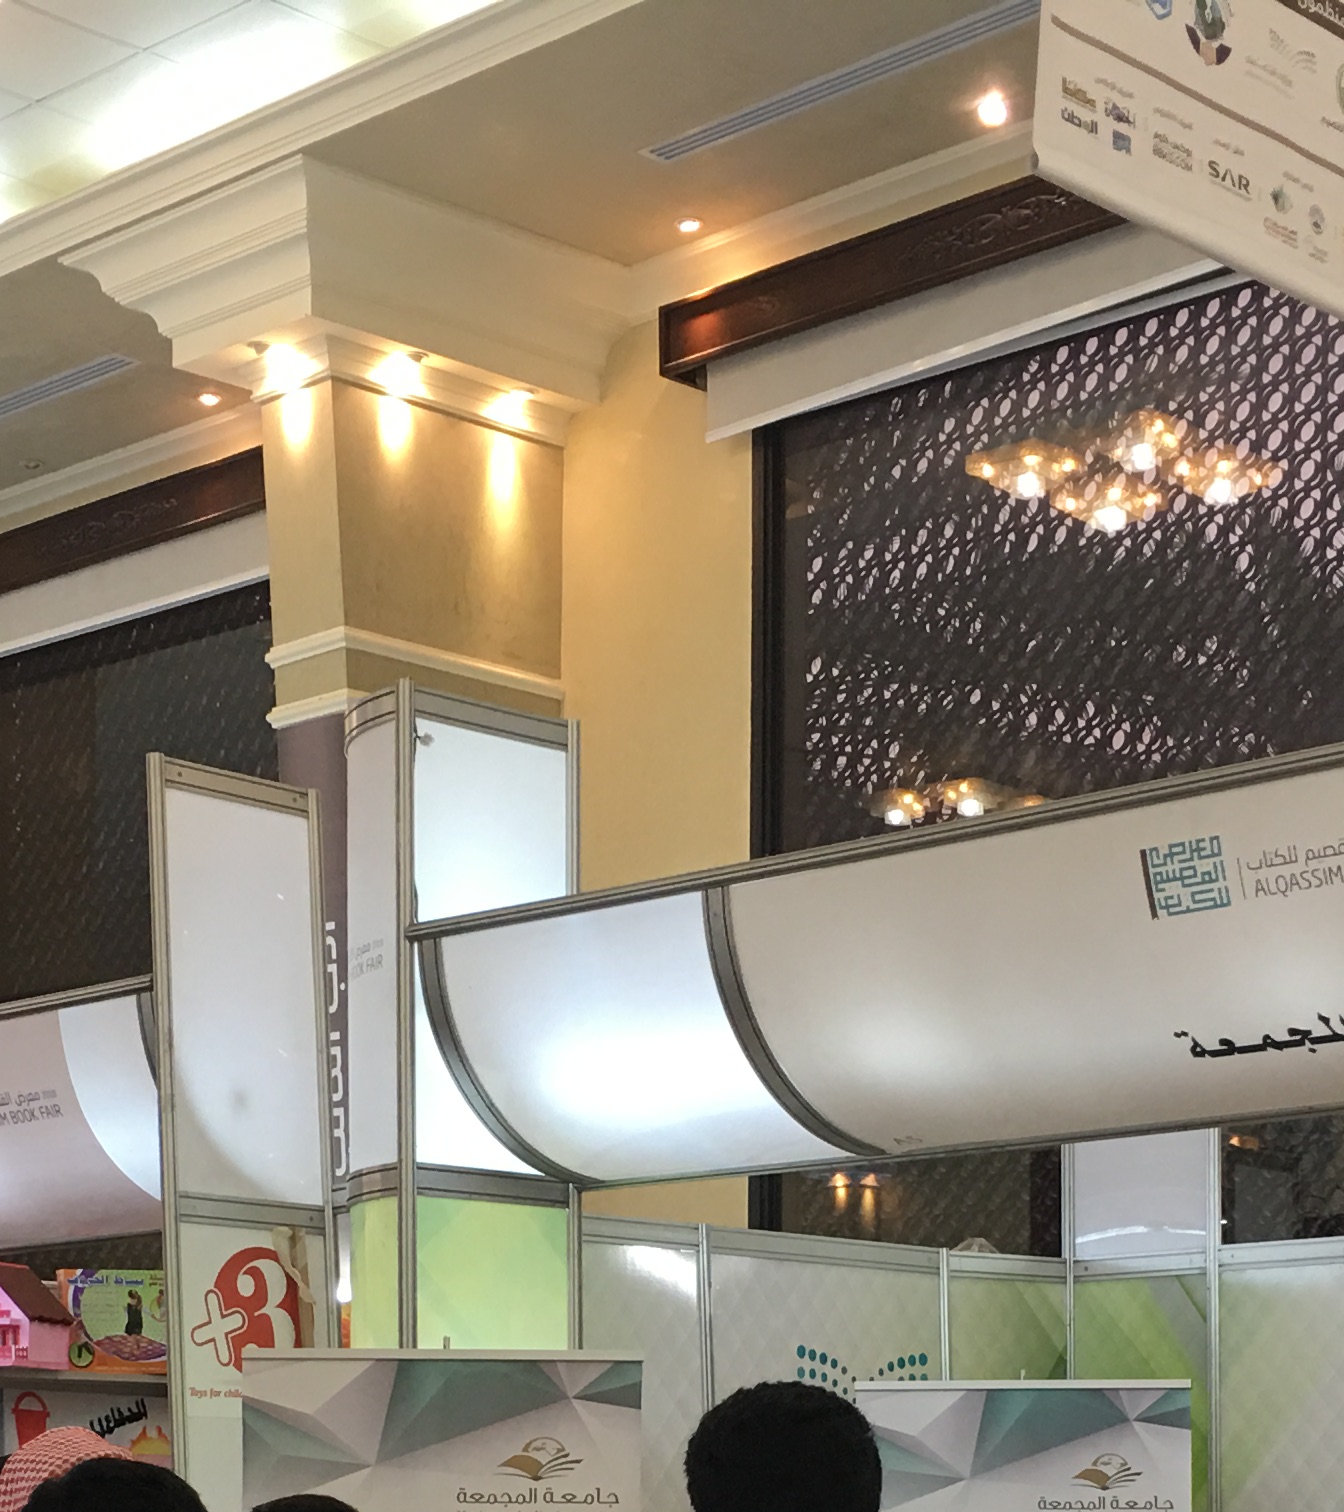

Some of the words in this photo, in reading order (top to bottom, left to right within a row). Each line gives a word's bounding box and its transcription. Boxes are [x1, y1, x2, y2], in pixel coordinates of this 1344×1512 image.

[1207, 159, 1250, 194] SAR
[1246, 845, 1299, 874] للكتاب
[1254, 864, 1344, 898] ALQASSIM
[9, 1107, 38, 1125] BOOK
[40, 1103, 64, 1121] FAIR
[188, 1387, 209, 1399] Toys
[209, 1387, 222, 1399] for
[456, 1487, 538, 1508] المجمعة
[542, 1487, 620, 1508] جامعة
[1037, 1495, 1106, 1512] المجمعة
[1109, 1495, 1175, 1512] جامعة
